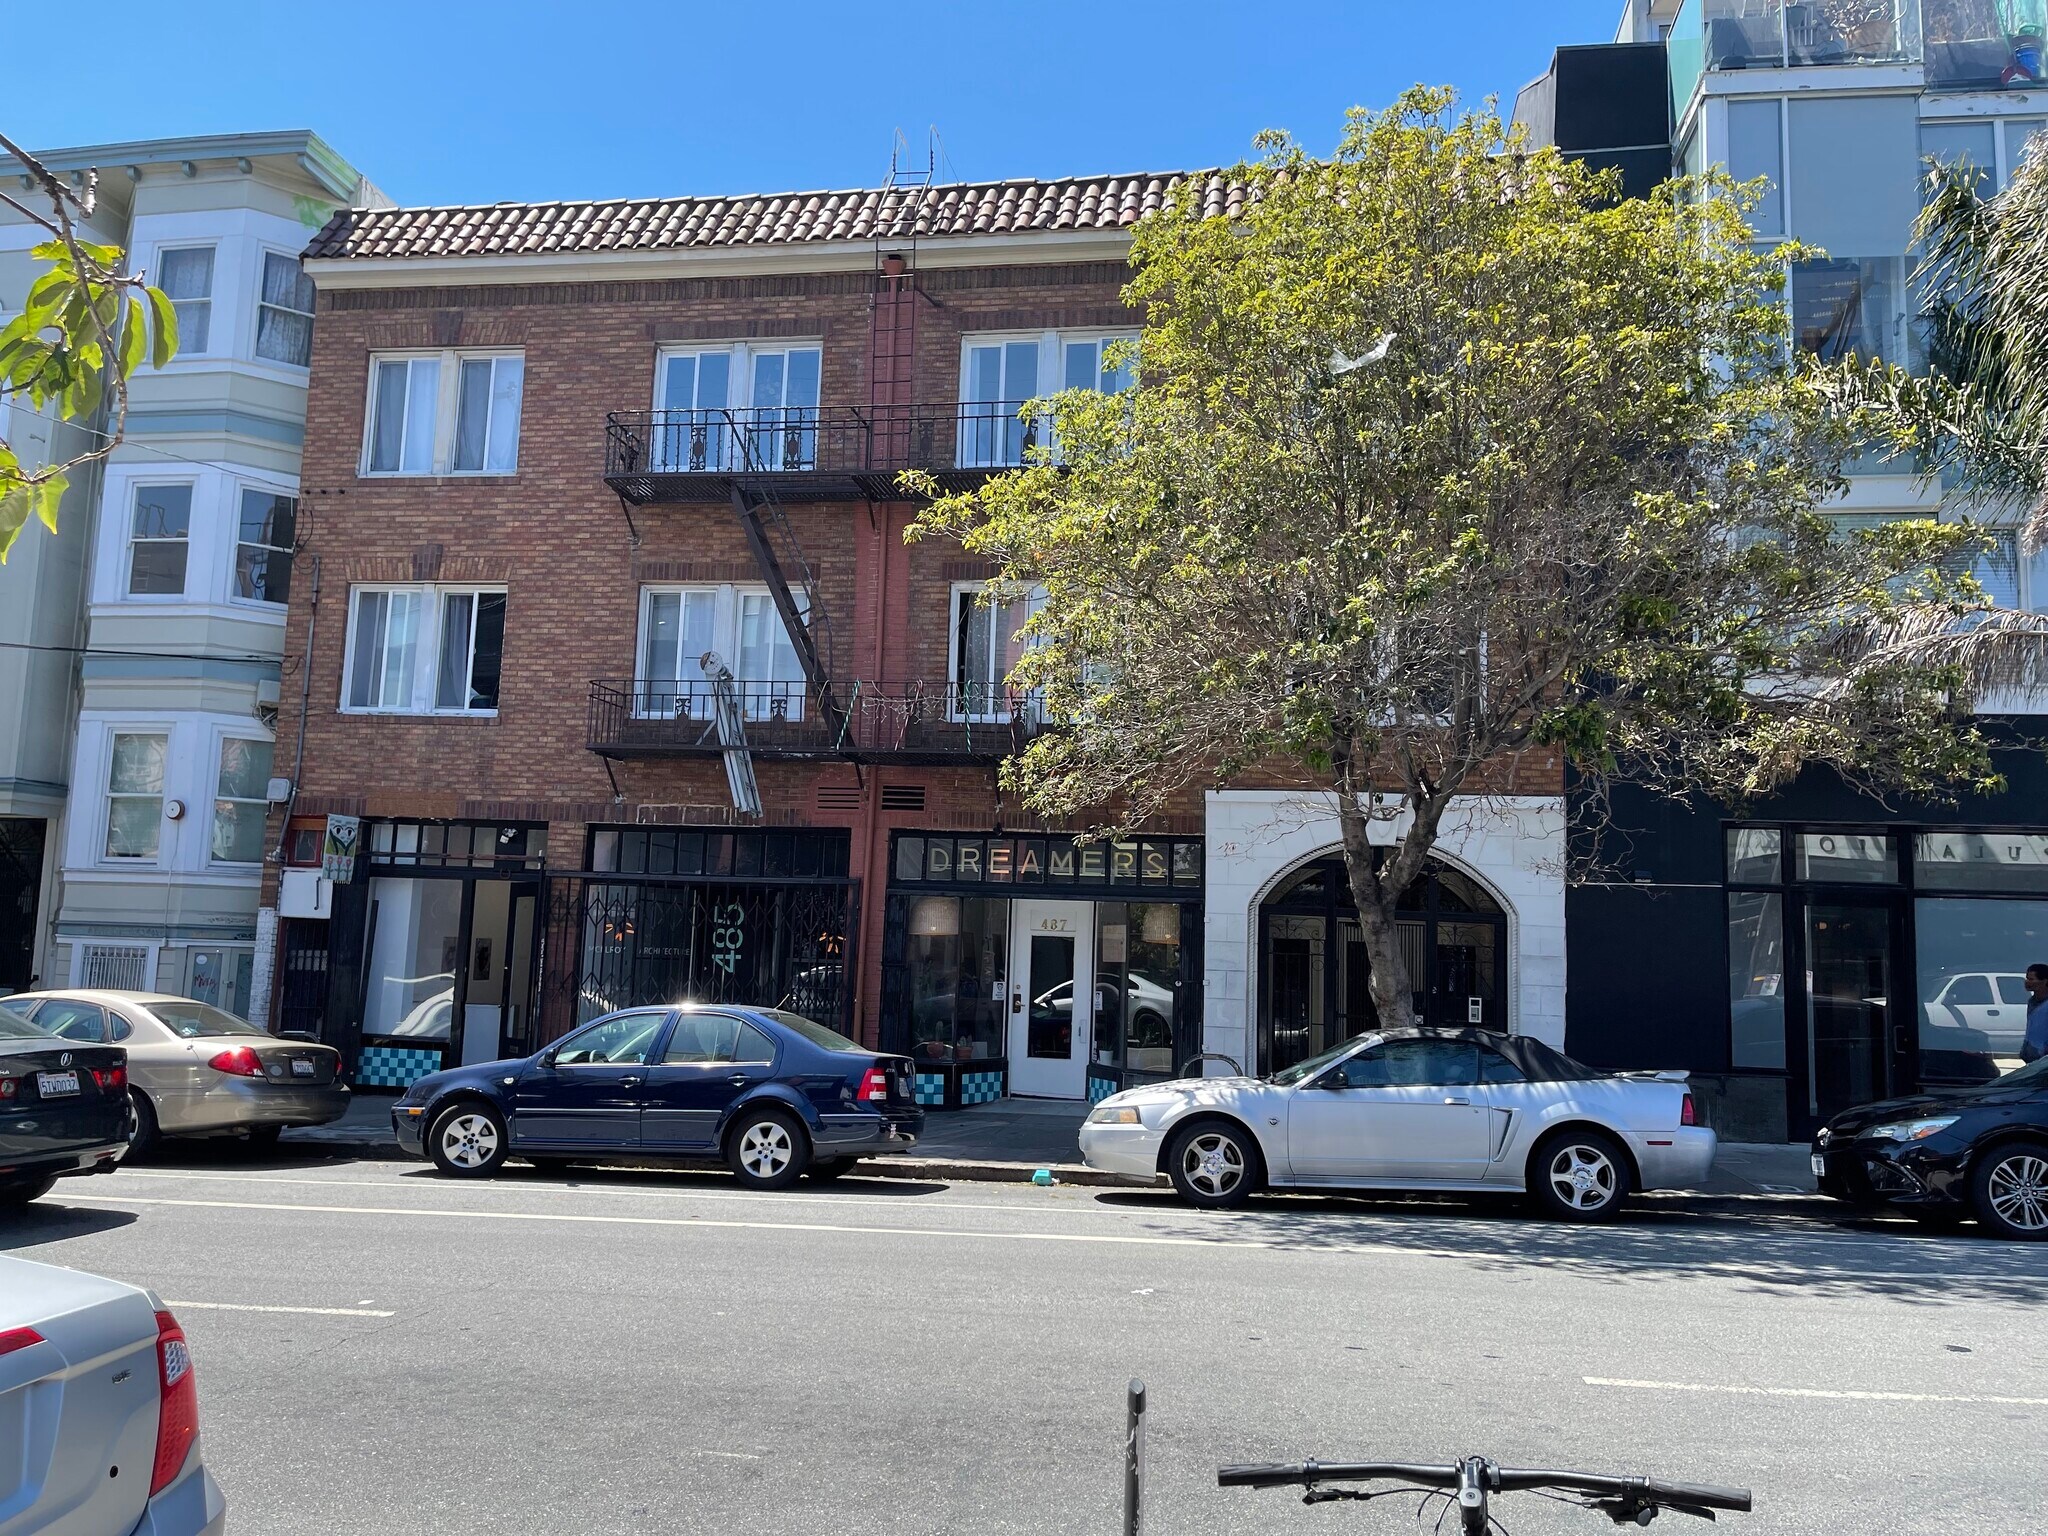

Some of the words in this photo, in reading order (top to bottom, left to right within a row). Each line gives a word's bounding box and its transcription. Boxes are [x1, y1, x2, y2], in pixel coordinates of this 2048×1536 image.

[930, 847, 1165, 878] DREAMERS
[711, 904, 745, 973] 485
[1041, 918, 1068, 931] 487
